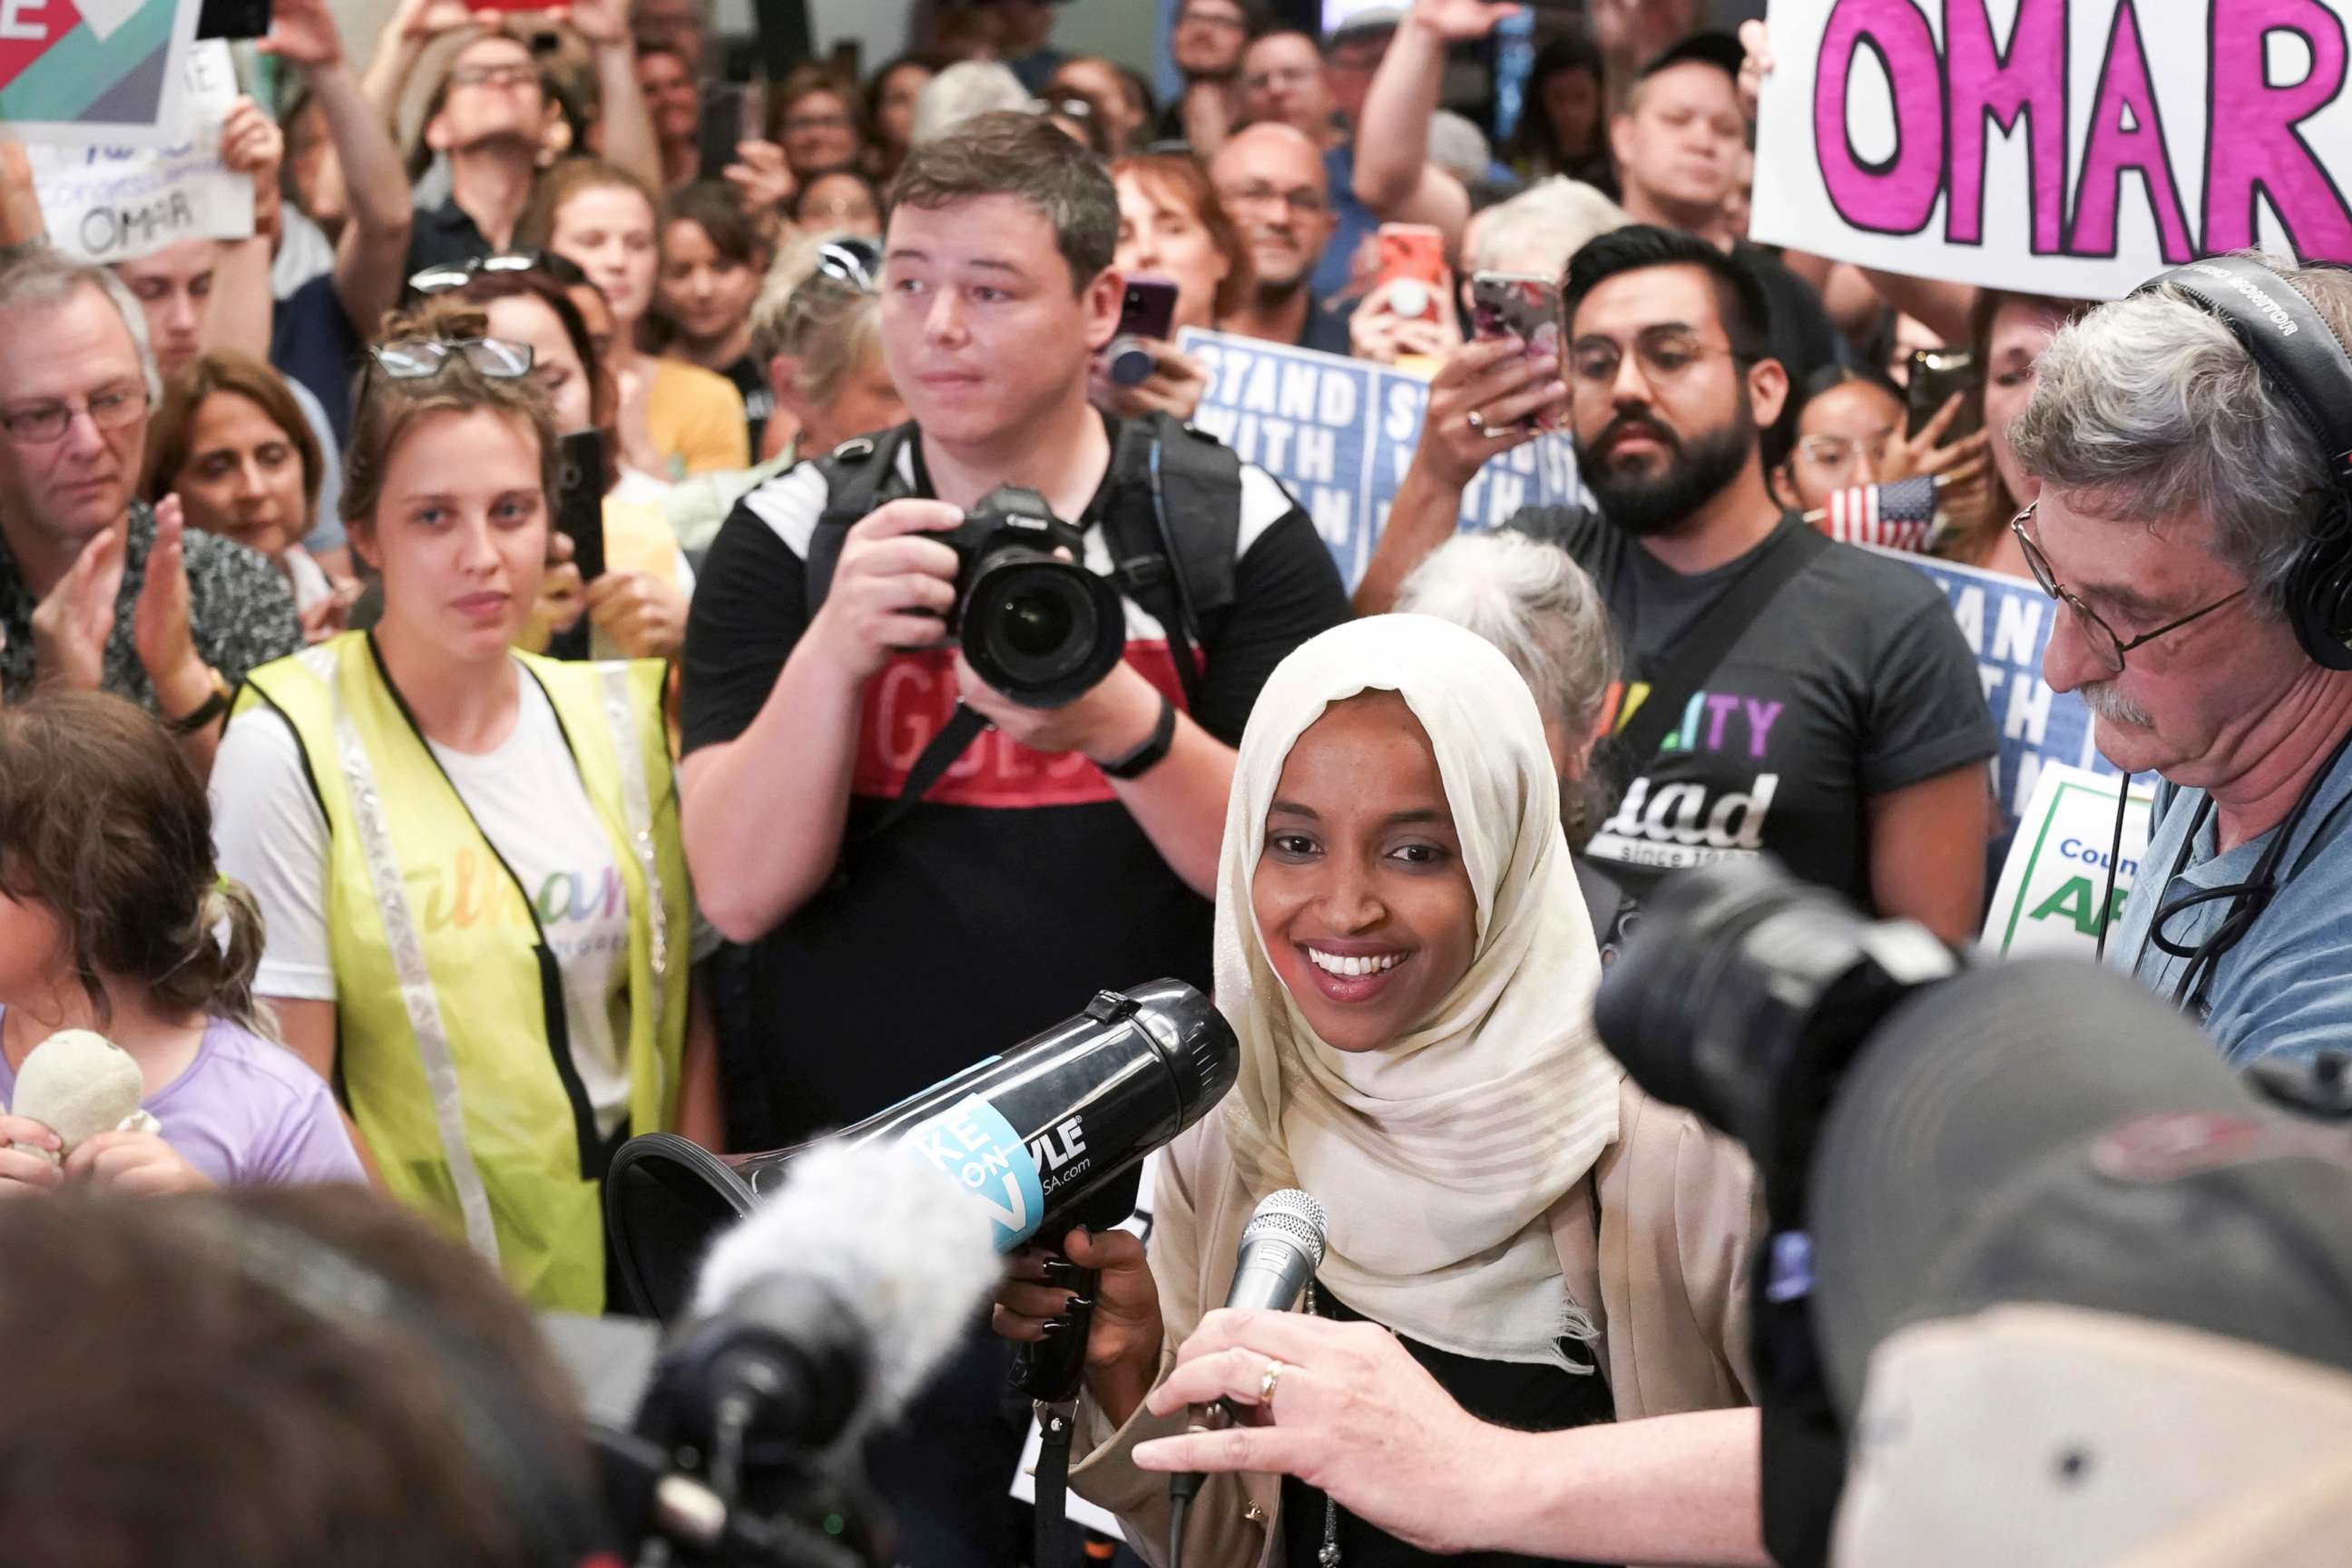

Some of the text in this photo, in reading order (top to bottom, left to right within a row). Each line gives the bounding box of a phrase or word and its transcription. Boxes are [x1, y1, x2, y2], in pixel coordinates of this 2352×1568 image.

[1814, 0, 2352, 266] OMAR
[80, 191, 193, 255] OMAR
[2227, 275, 2299, 337] MONITOR
[1191, 344, 1357, 428] STAND
[1621, 842, 1684, 868] since
